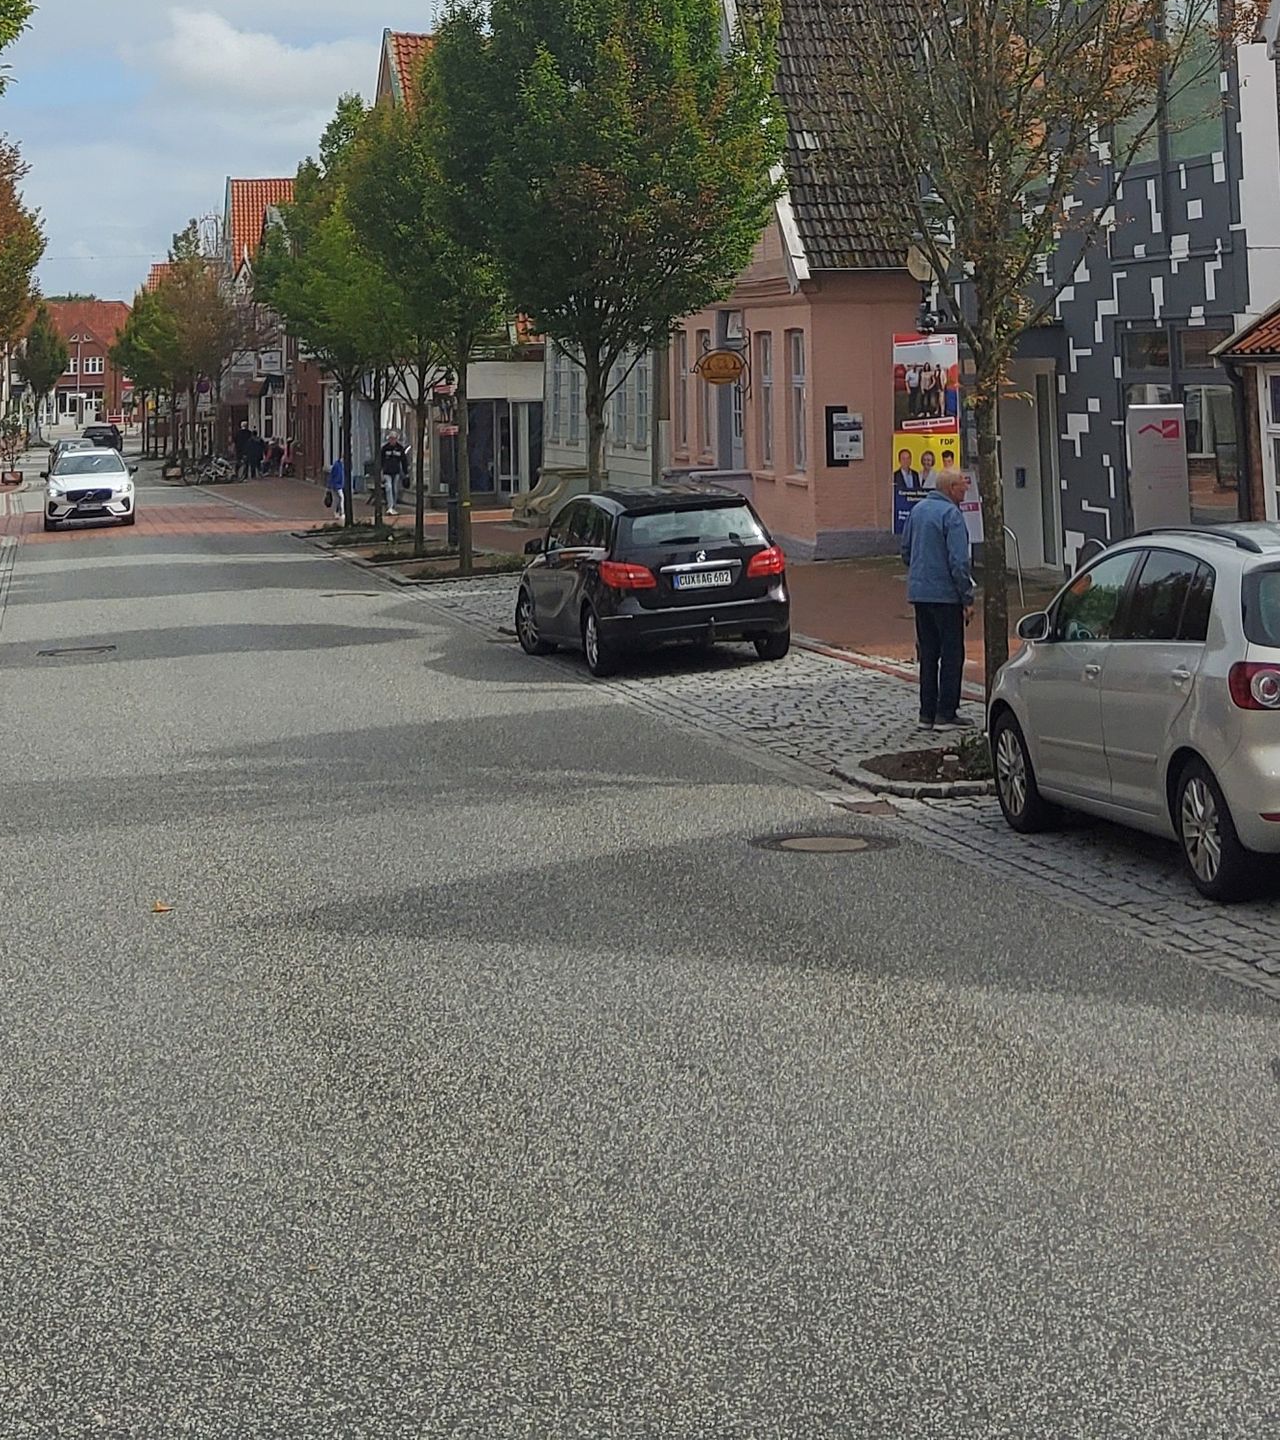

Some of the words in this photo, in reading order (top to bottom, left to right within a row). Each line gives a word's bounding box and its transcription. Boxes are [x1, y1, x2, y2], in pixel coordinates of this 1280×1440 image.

[940, 438, 955, 446] FDP
[680, 574, 696, 586] CUX
[702, 573, 712, 584] AG
[714, 572, 729, 583] 602
